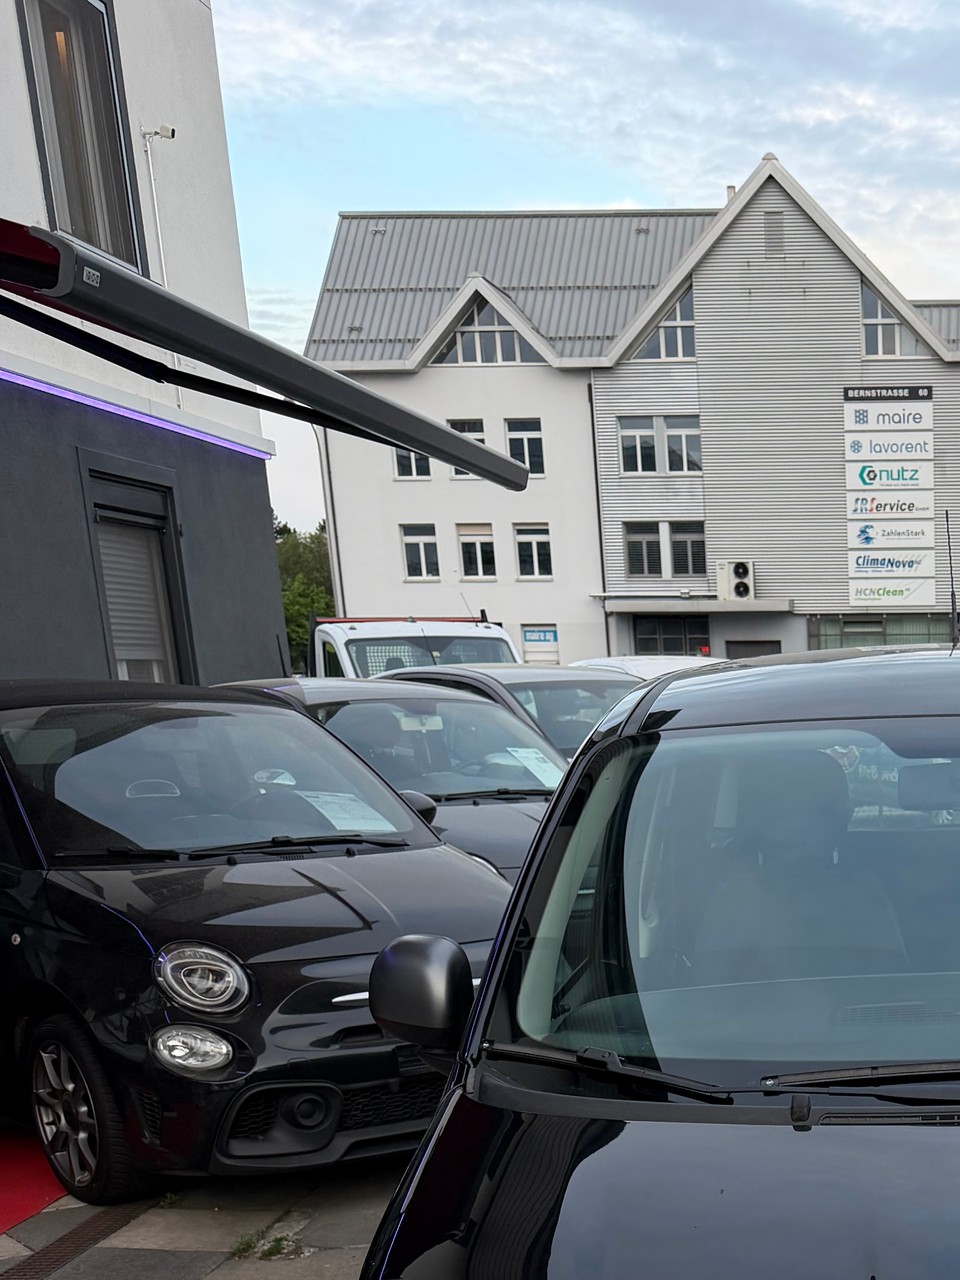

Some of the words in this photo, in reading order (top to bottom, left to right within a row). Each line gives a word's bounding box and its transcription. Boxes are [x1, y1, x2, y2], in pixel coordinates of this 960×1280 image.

[848, 389, 909, 397] BERNSTRASSE
[918, 388, 928, 396] 60
[876, 409, 923, 424] maire
[869, 440, 929, 454] lavorent
[881, 529, 926, 537] ZahlenStark
[856, 555, 914, 569] ClimaNova
